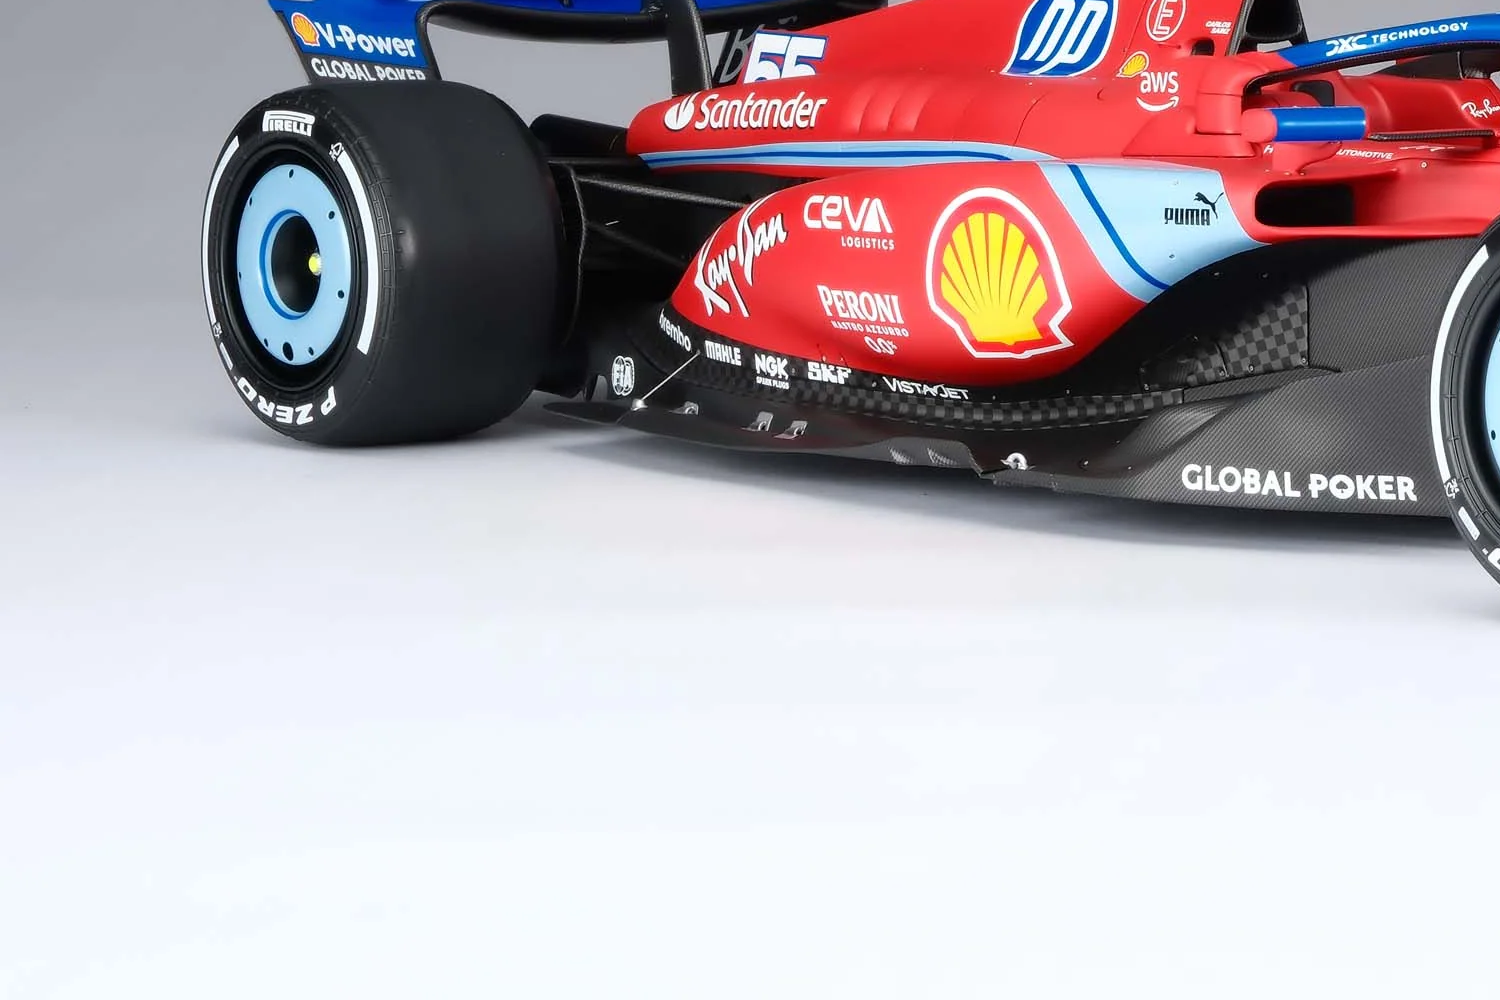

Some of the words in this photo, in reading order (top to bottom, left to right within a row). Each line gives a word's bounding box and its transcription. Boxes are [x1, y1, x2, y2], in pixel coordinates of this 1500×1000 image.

[314, 22, 416, 58] V-Power
[1326, 34, 1368, 57] DXC
[1371, 22, 1469, 45] TECHNOLOGY
[311, 57, 377, 82] GLOBAL
[374, 65, 426, 81] POKER
[743, 33, 828, 84] 55
[1140, 71, 1179, 94] aws
[262, 110, 315, 137] PIRELLI
[694, 91, 828, 130] Santander
[1164, 207, 1211, 226] PUMA
[841, 236, 895, 250] LOGISTICS
[817, 284, 904, 325] PERONI
[659, 308, 692, 352] brembo
[831, 320, 864, 334] NASTRO
[866, 324, 910, 338] AZZURRO
[704, 340, 742, 367] MAHLE
[754, 353, 789, 381] NGK
[807, 361, 852, 385] SKF
[237, 376, 314, 426] ZERO
[320, 385, 337, 416] P
[1182, 463, 1301, 498] GLOBAL
[1308, 473, 1418, 502] POKER
